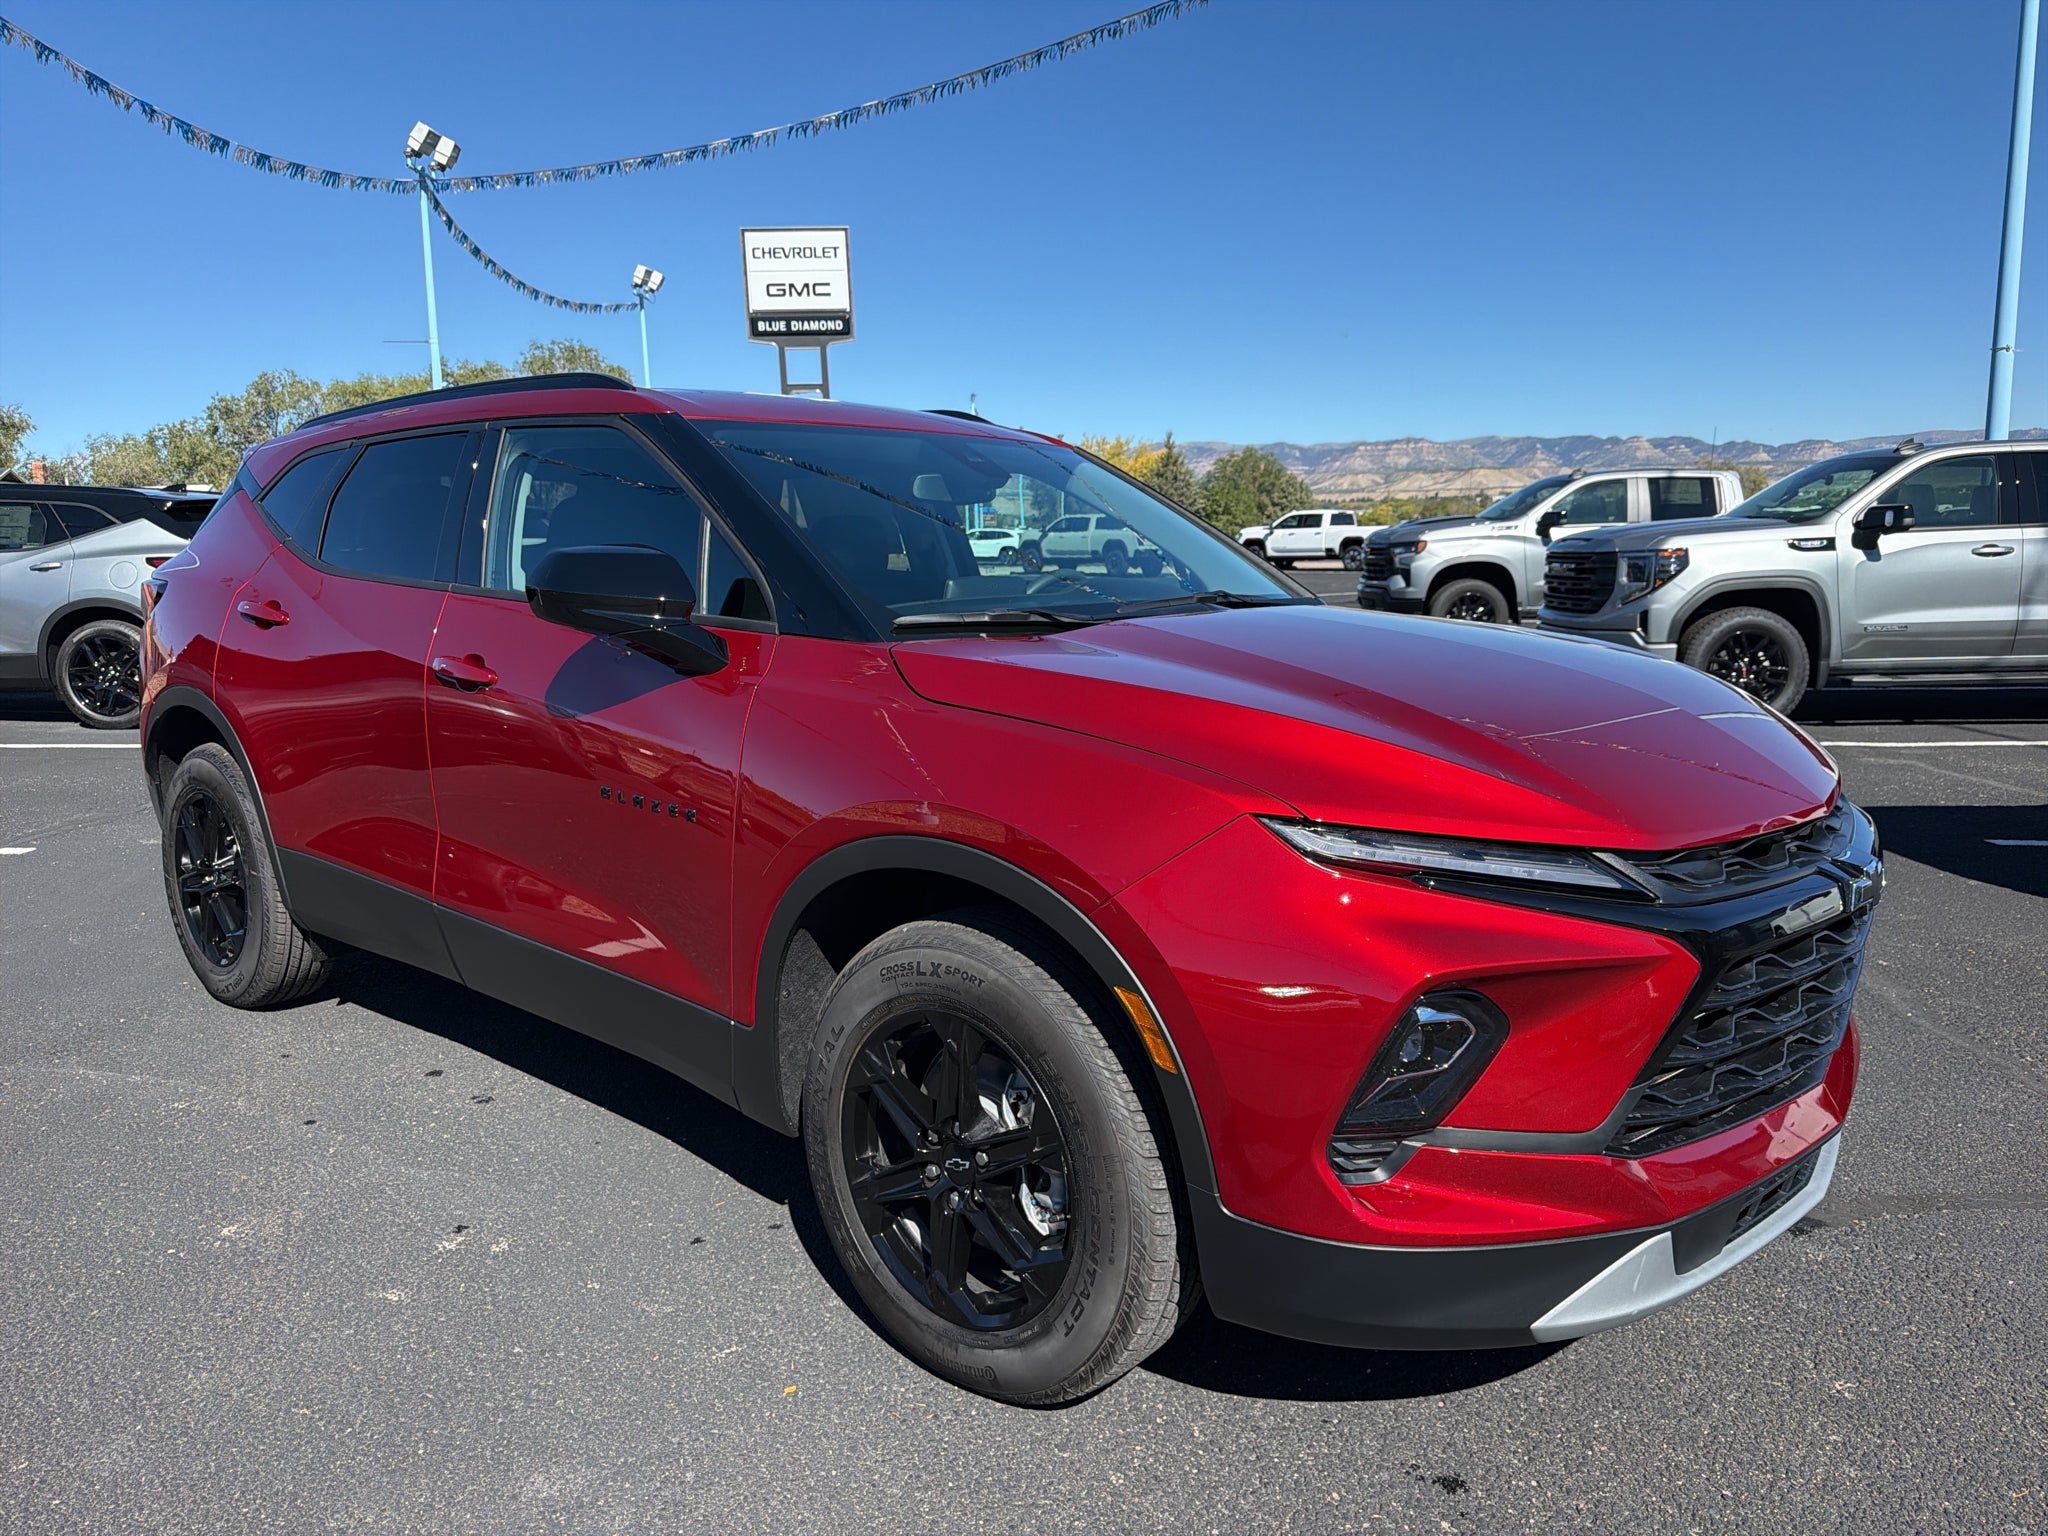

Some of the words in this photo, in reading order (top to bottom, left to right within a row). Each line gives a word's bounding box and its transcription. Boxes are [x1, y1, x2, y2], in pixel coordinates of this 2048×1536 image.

[752, 246, 840, 259] CHEVROLET
[766, 282, 831, 297] GMC
[757, 320, 787, 332] BLUE
[791, 320, 843, 332] DIAMOND
[600, 785, 696, 823] BLAZER
[880, 961, 914, 977] CROSS
[916, 961, 942, 978] LX
[944, 965, 986, 988] SPORT
[881, 971, 915, 984] CONTACT
